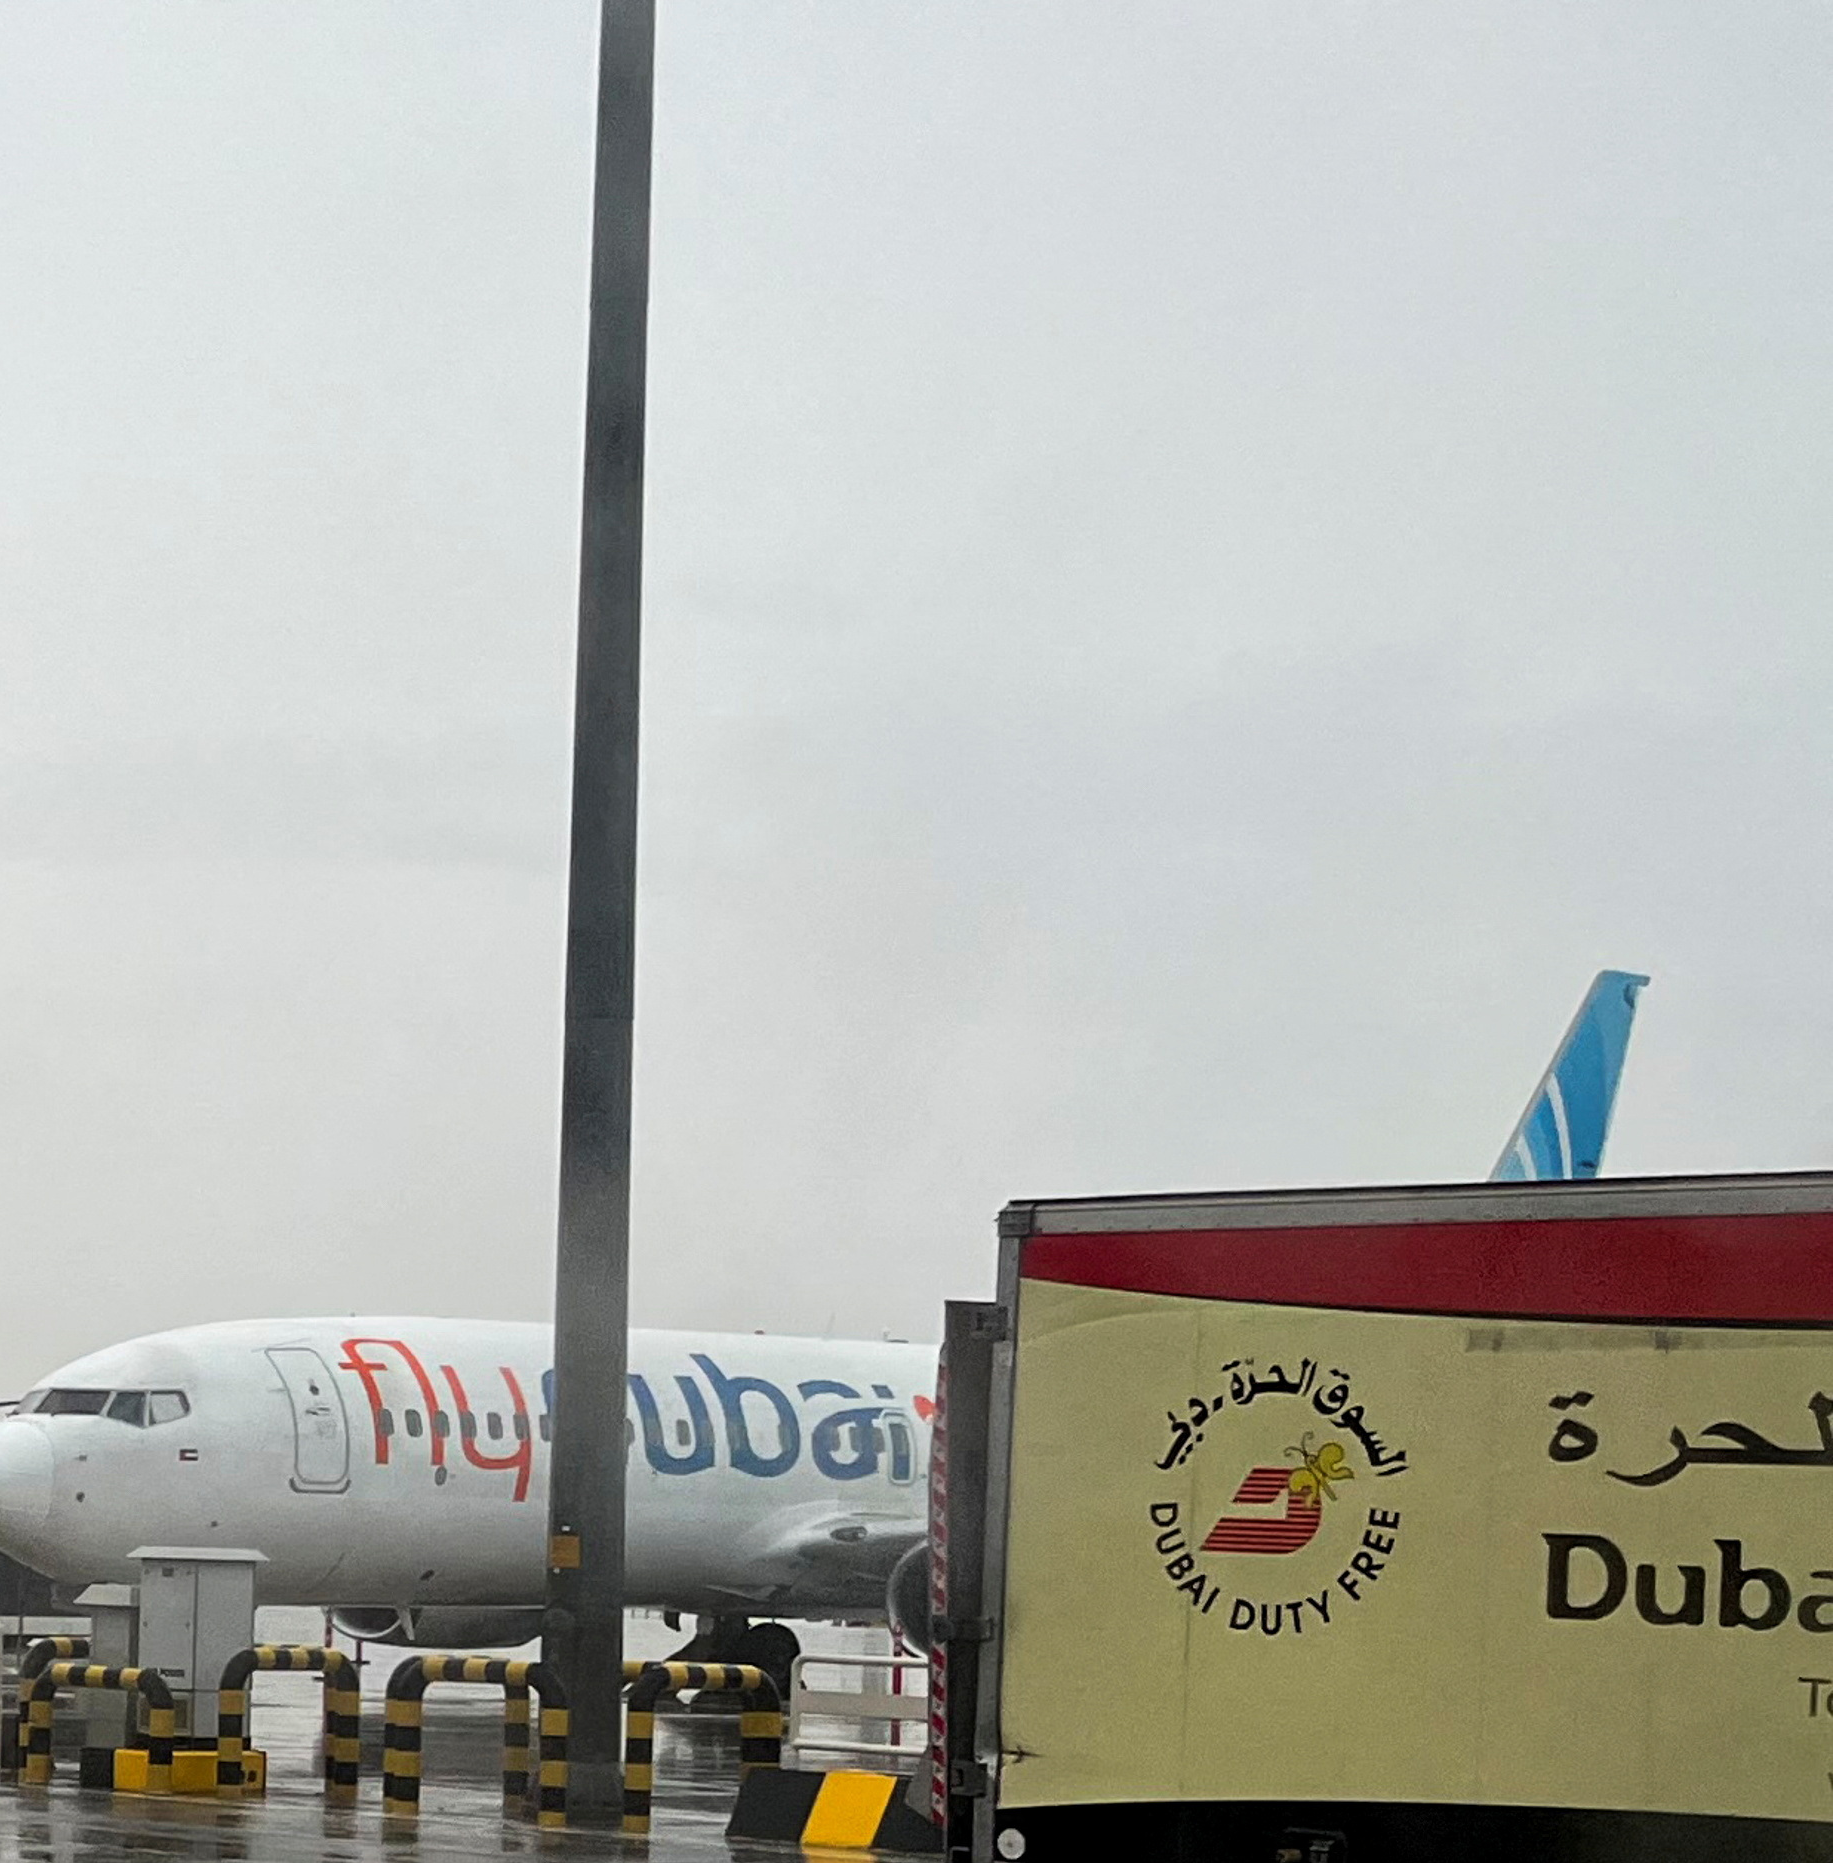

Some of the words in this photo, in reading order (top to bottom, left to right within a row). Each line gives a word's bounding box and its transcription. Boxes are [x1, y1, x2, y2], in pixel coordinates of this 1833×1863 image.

[338, 1337, 911, 1502] flyubai
[1150, 1502, 1221, 1614] DUBAI
[1229, 1589, 1331, 1636] DUTY
[1336, 1508, 1401, 1602] FREE
